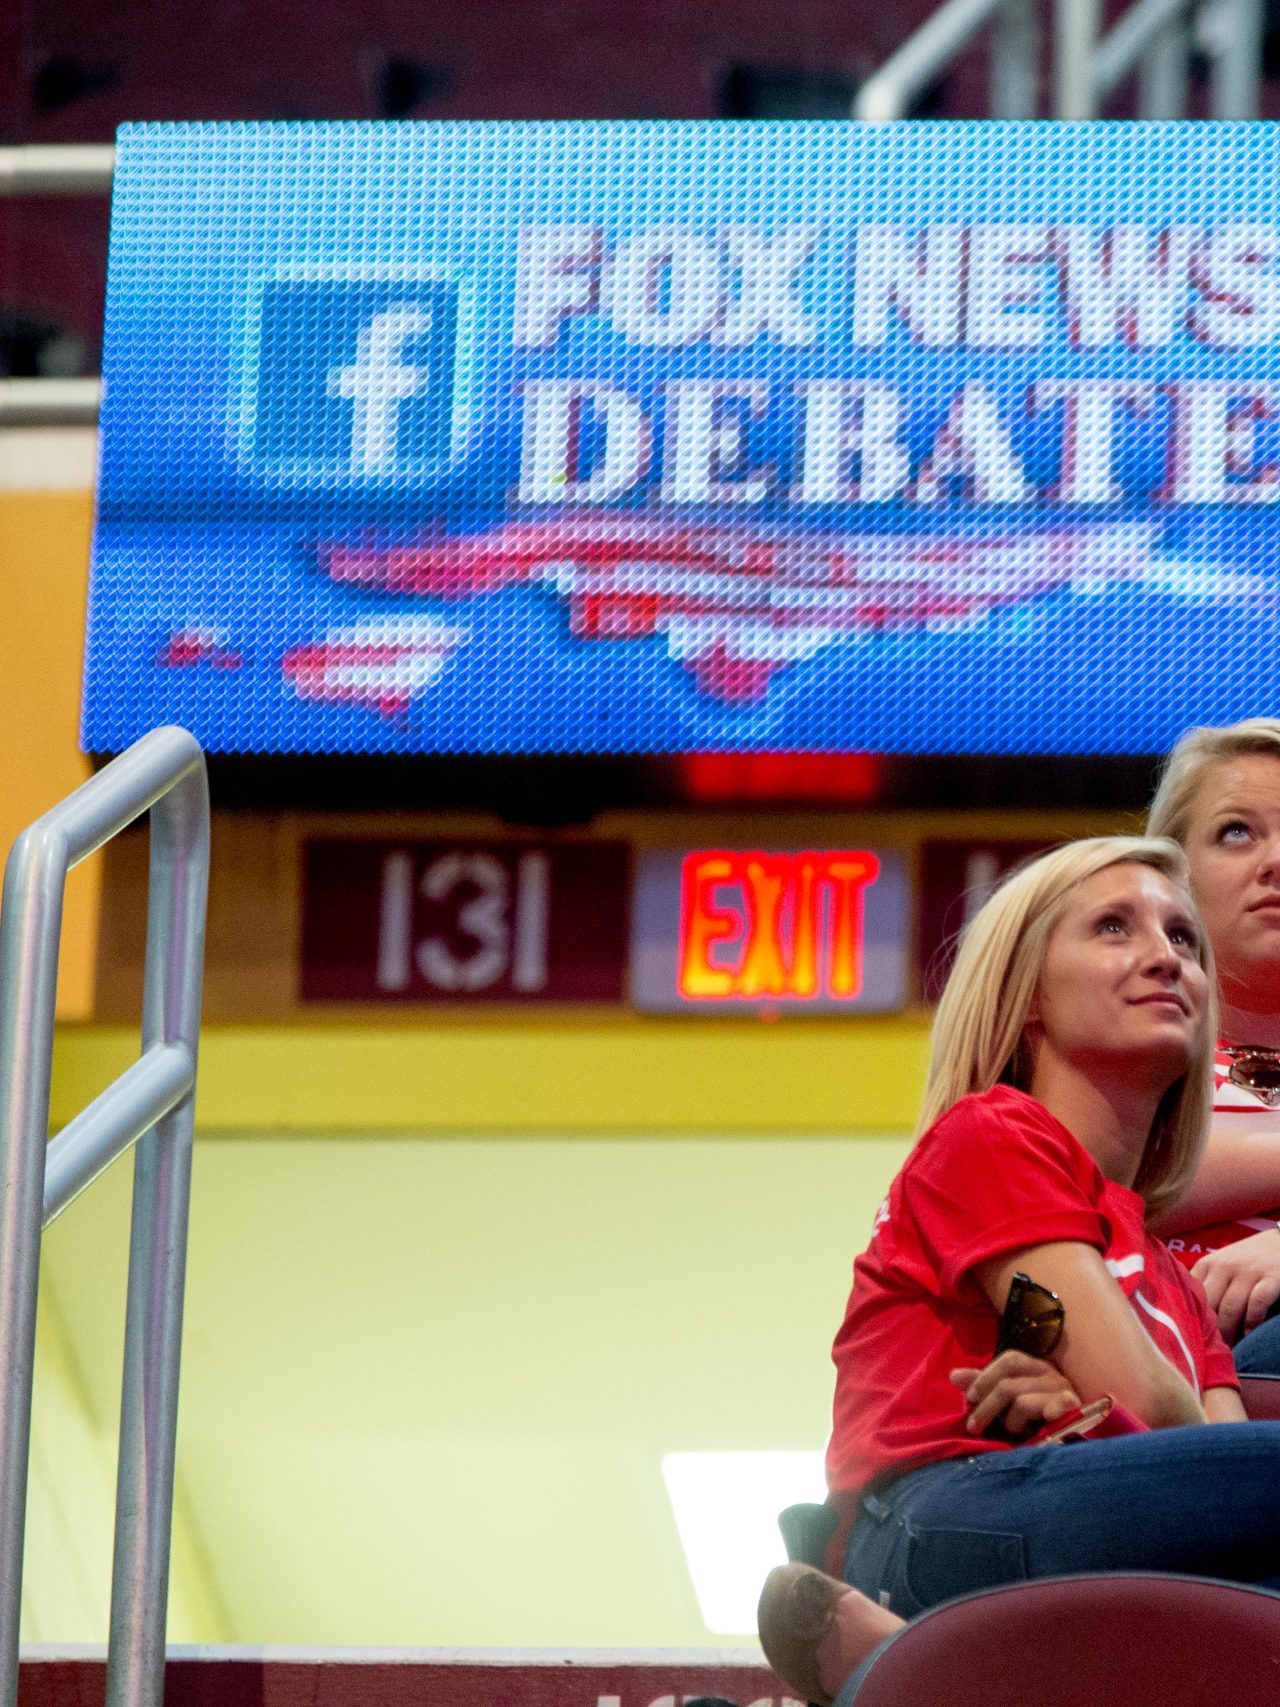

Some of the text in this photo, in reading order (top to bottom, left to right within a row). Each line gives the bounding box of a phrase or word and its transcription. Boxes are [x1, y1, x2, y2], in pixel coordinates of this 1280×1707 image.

[514, 222, 824, 349] FOX
[377, 850, 551, 992] 131
[677, 850, 880, 999] EXIT
